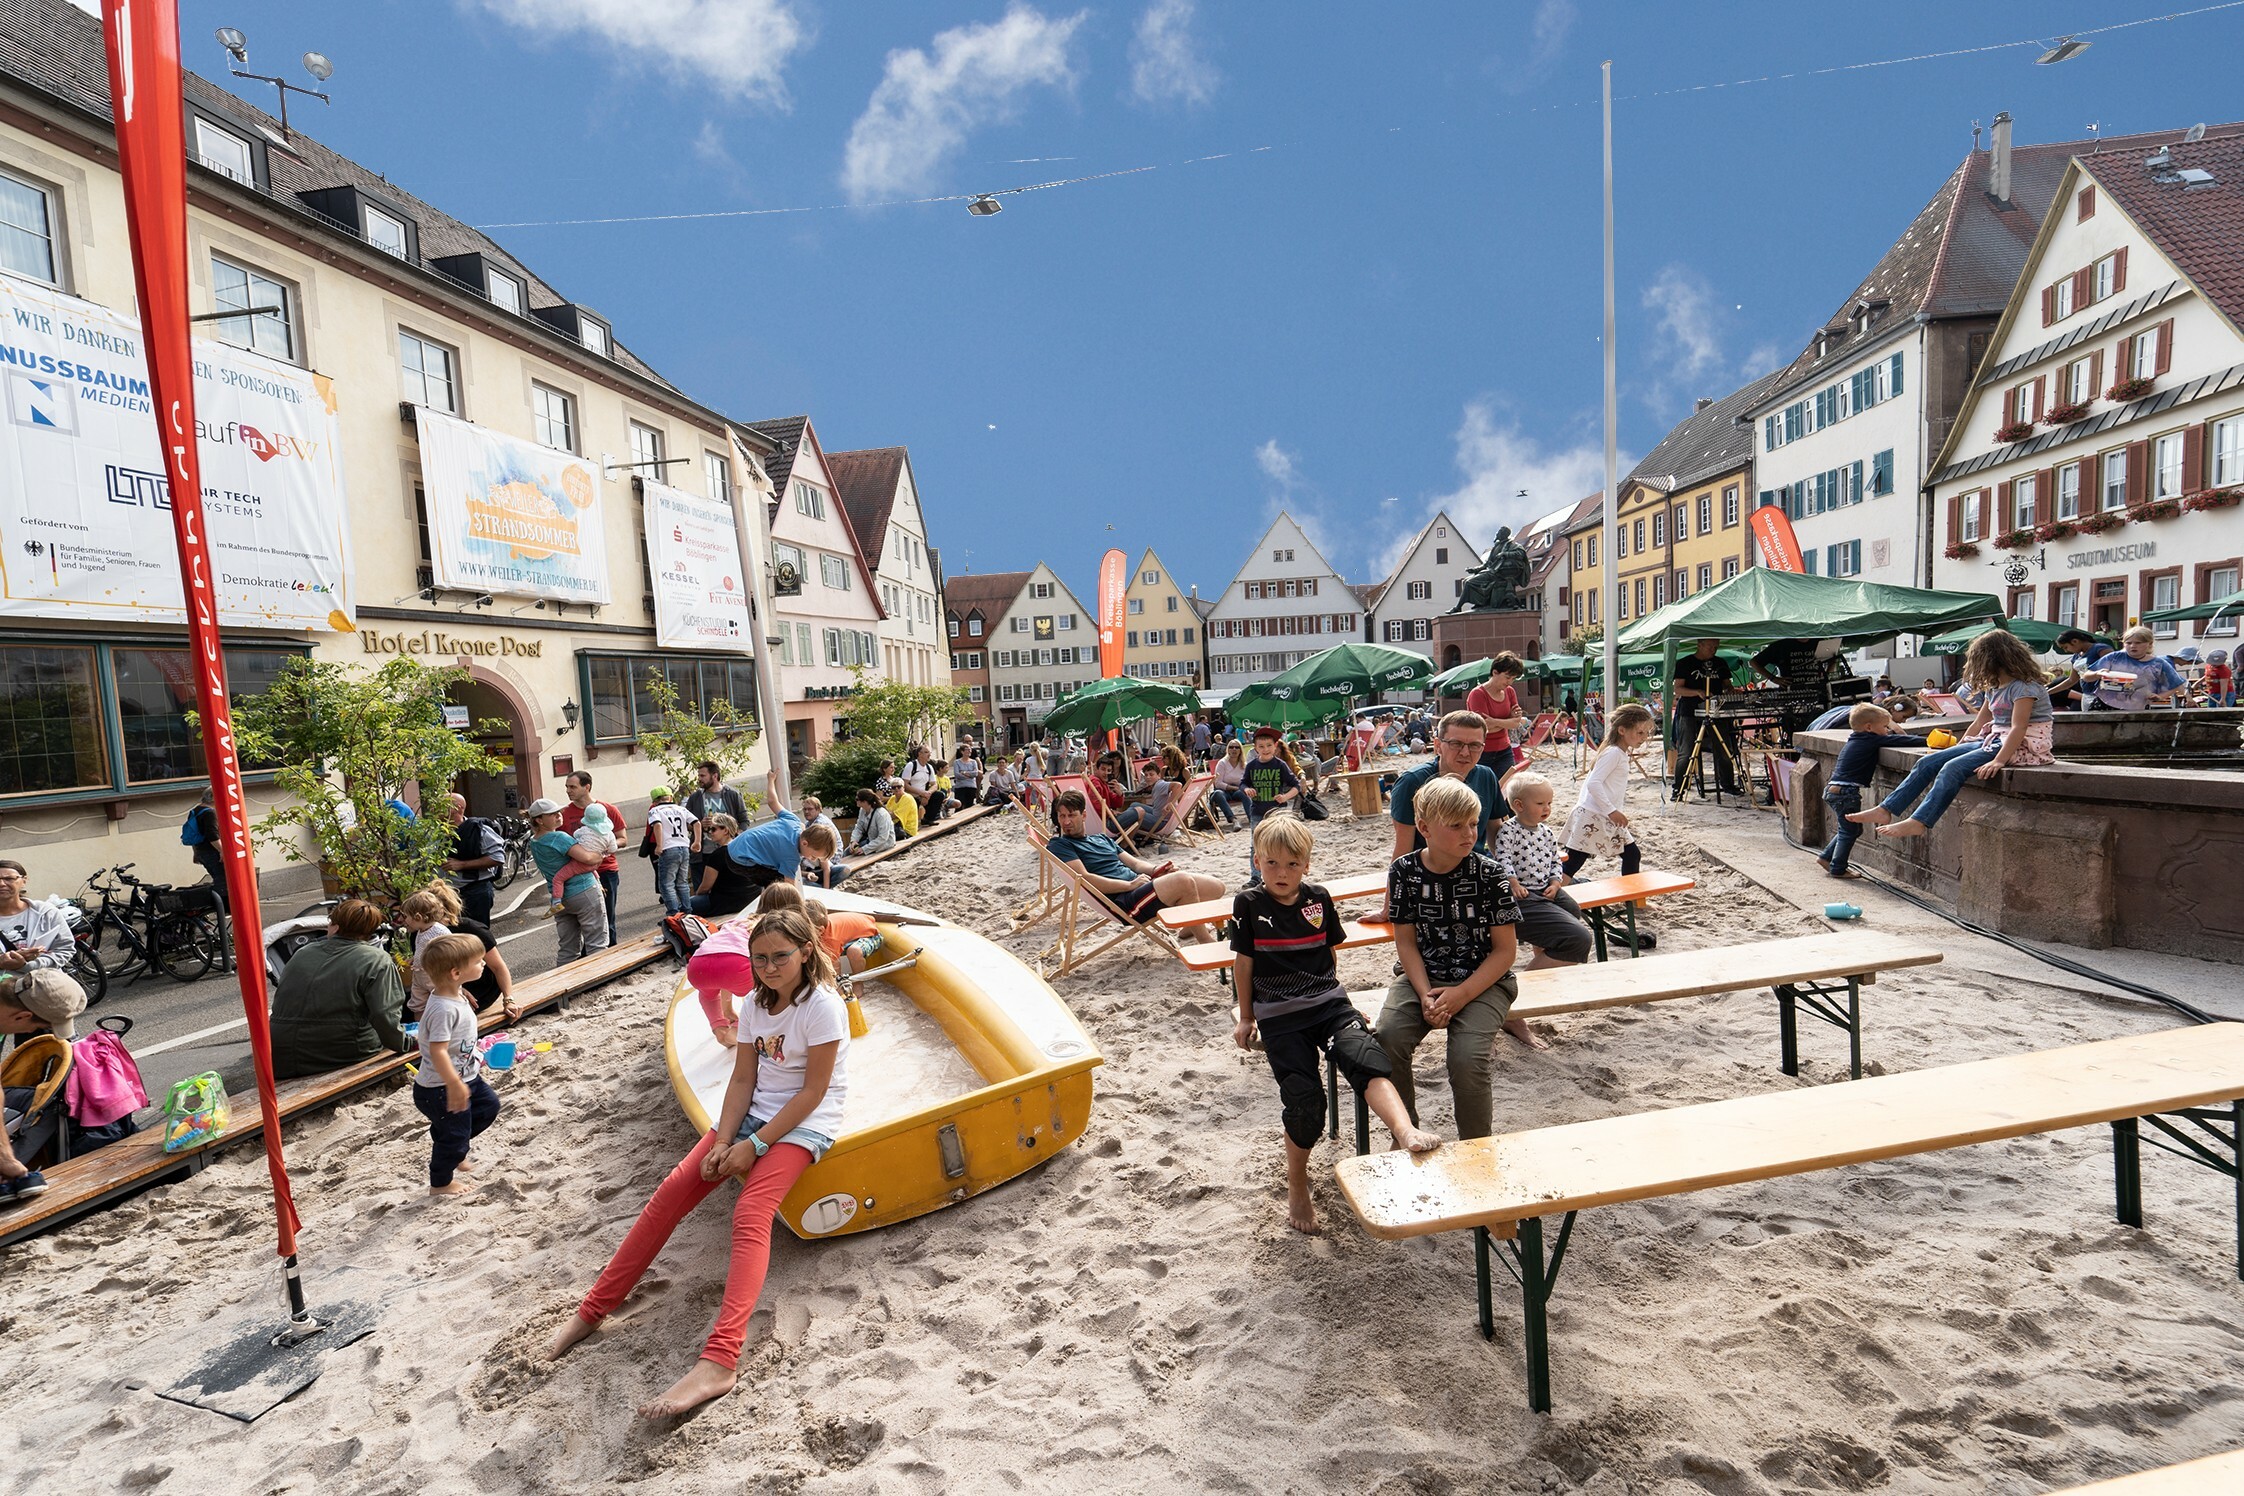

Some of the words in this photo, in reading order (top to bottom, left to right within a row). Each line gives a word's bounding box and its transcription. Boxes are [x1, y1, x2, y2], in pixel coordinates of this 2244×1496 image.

[13, 307, 52, 335] WIR
[62, 322, 136, 358] DANKEN
[0, 344, 150, 398] NUSSBAUM
[81, 387, 150, 413] MEDIEN
[224, 490, 261, 505] TECH
[509, 488, 540, 514] WEILER
[204, 501, 263, 519] YSTEMS
[20, 516, 67, 530] Gefördert
[68, 523, 90, 532] vom
[473, 512, 577, 550] STRANDSOMMER
[59, 543, 133, 558] Bundesministerium
[216, 541, 227, 549] im
[228, 542, 258, 553] Rahmen
[259, 546, 270, 554] des
[685, 536, 730, 554] Kreissparkasse
[60, 552, 72, 561] für
[73, 553, 105, 565] Familie,
[106, 556, 138, 568] Senioren,
[138, 560, 161, 569] Frauen
[686, 548, 718, 562] Böblingen
[2067, 541, 2158, 569] STADTMUSEUM
[61, 562, 77, 570] und
[79, 562, 106, 573] Jugend
[222, 573, 289, 589] Demokratie
[661, 571, 700, 585] KESSEL
[1105, 557, 1117, 627] Kreissparkasse
[1115, 580, 1124, 628] Böblingen
[682, 613, 728, 629] KÜCHENSTUDIO
[696, 627, 728, 637] SCHINDELE
[362, 629, 431, 654] Hotel
[434, 632, 498, 657] Krone
[500, 635, 543, 658] Post
[1627, 667, 1653, 676] Hochdorfer
[804, 686, 830, 698] Buch
[1320, 682, 1351, 695] Hochdorfer
[1253, 769, 1281, 780] HAVE
[668, 816, 684, 838] 13
